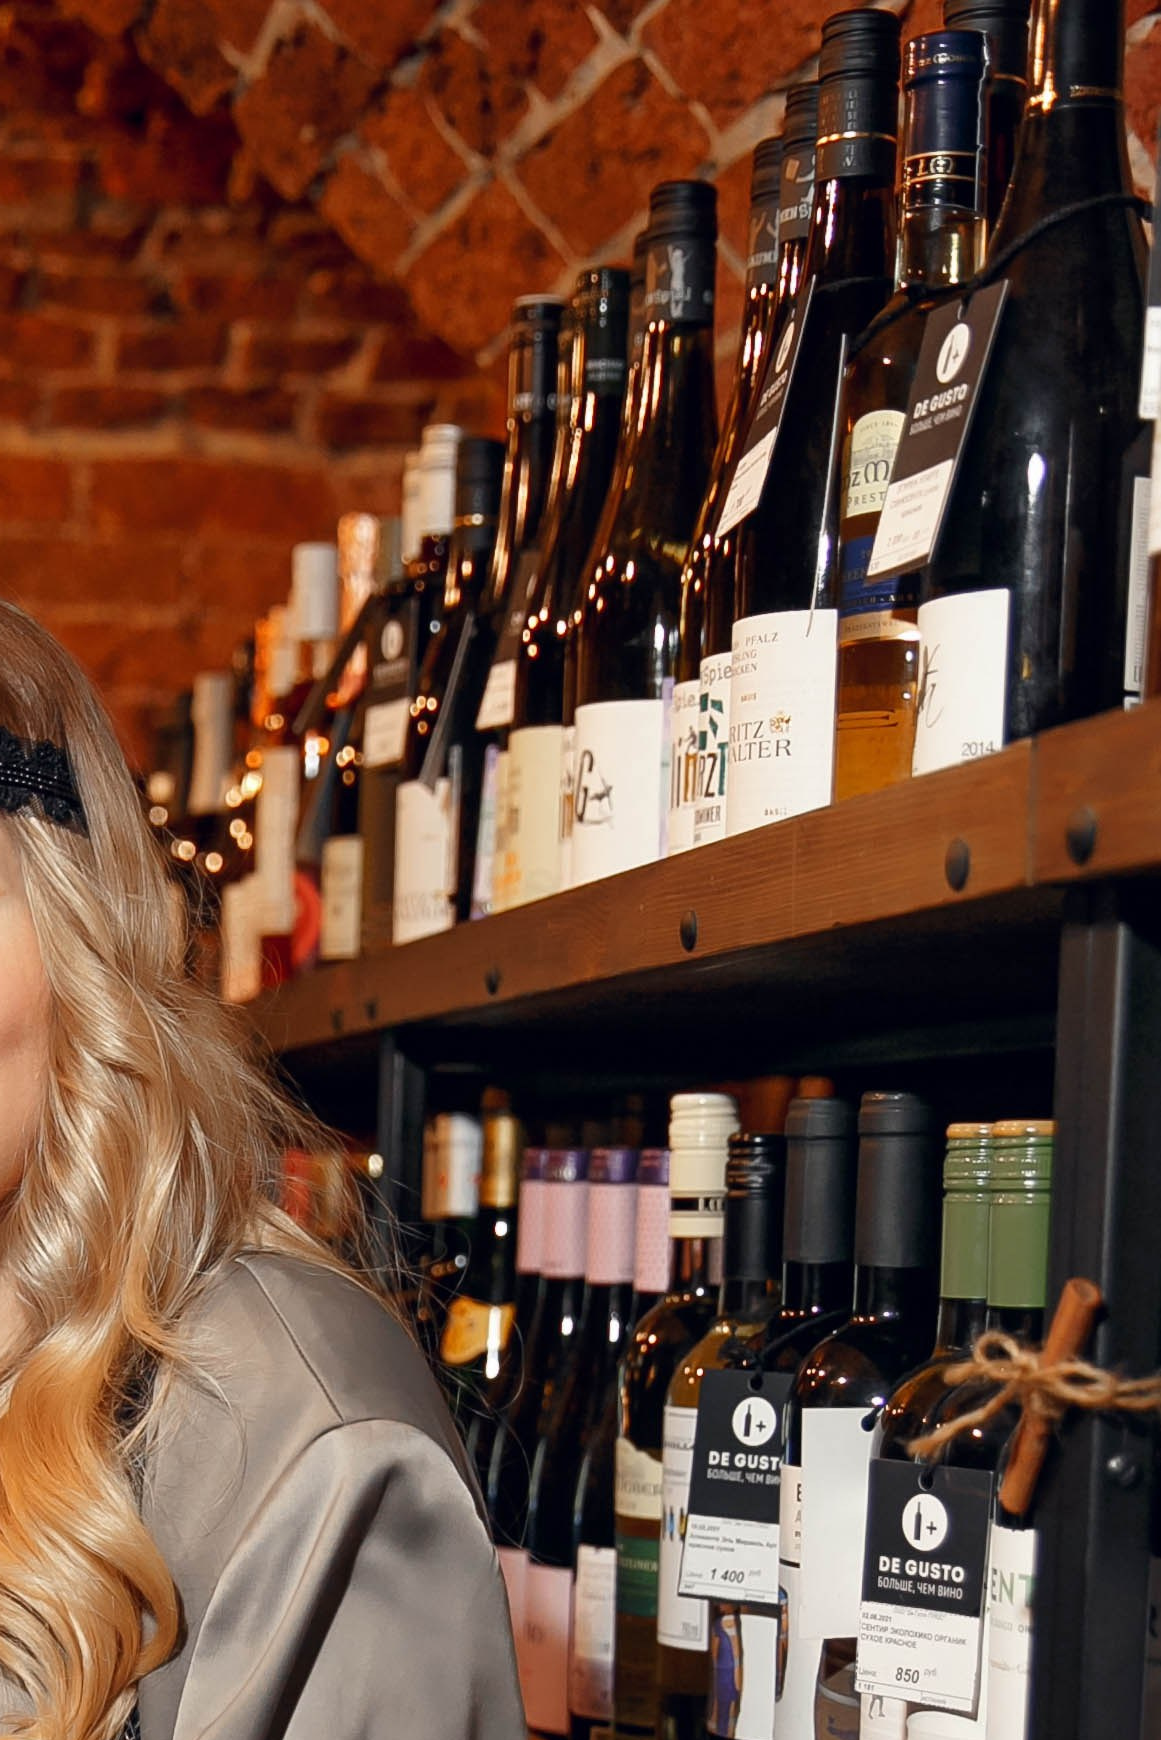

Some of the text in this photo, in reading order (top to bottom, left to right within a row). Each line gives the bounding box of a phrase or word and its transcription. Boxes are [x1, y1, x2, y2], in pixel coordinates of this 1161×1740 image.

[913, 384, 968, 419] DE GUSTO
[745, 632, 778, 647] PFALZ
[961, 740, 997, 758] 2014
[708, 1450, 782, 1471] DE GUST
[721, 1570, 745, 1584] 400
[878, 1556, 966, 1583] DE GUSTO
[877, 1577, 963, 1600] БОЛЬШЕ, ЧЕМ ВИНО
[895, 1667, 920, 1684] 850
